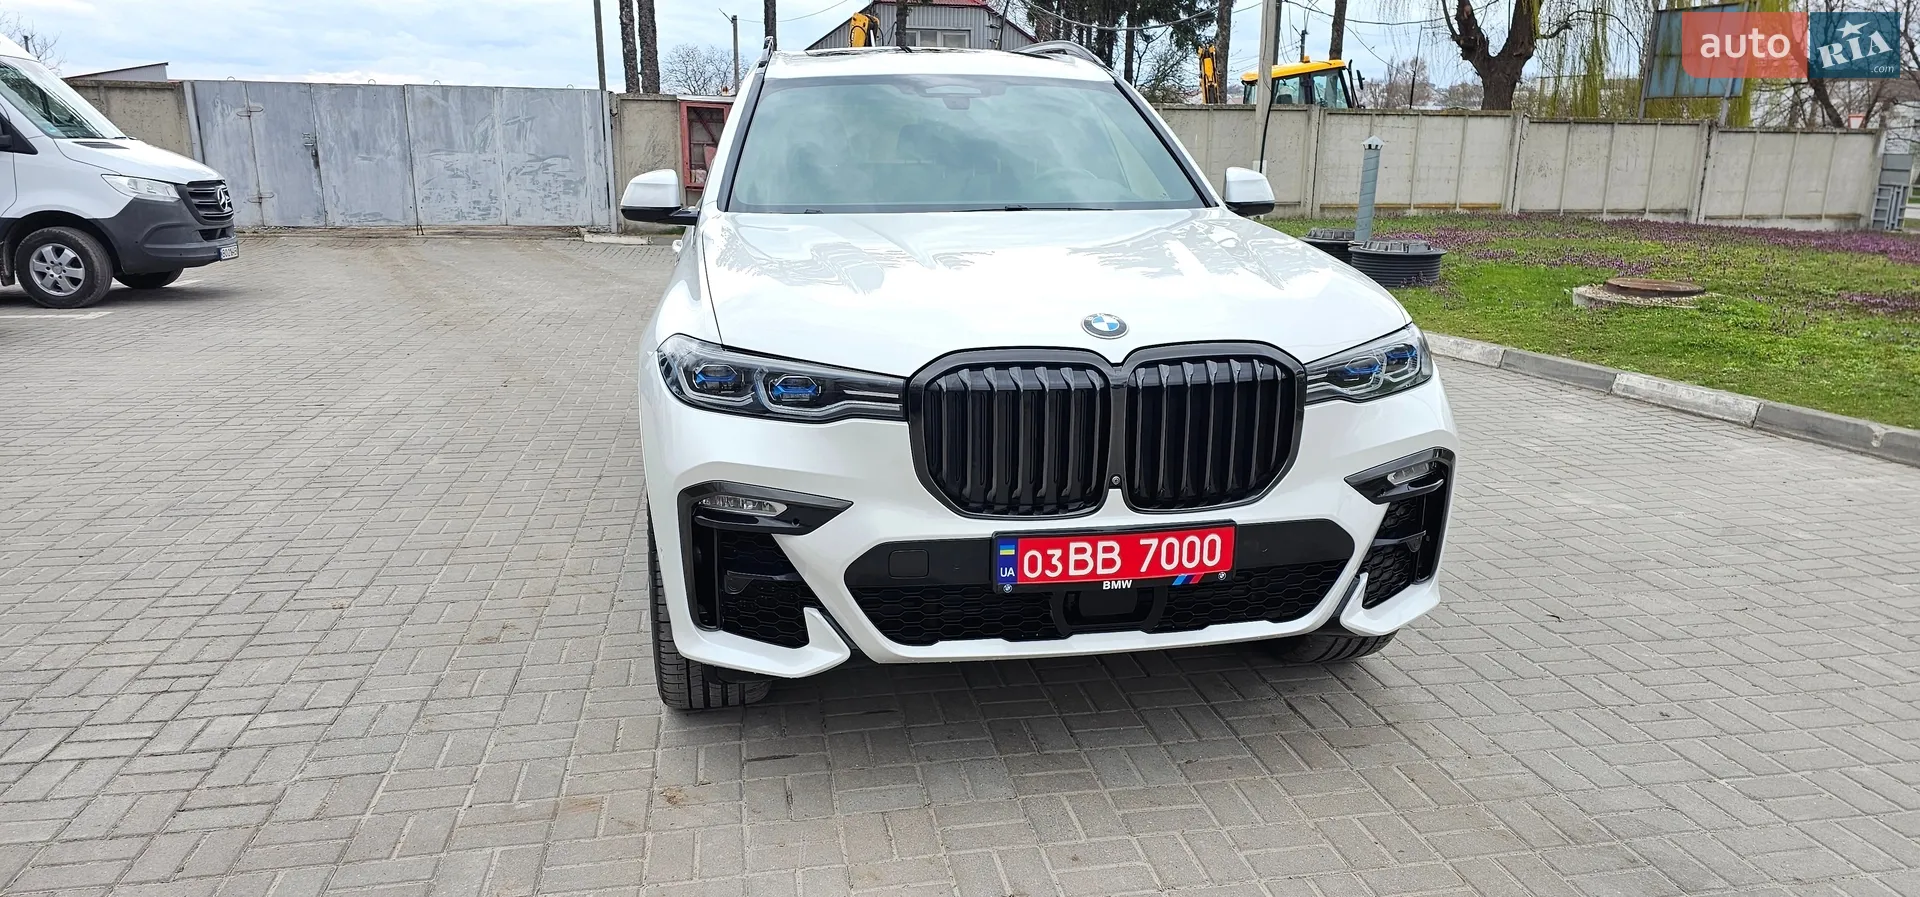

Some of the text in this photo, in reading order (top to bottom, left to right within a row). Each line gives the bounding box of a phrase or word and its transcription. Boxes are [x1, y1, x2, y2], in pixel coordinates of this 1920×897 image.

[1139, 533, 1222, 573] 7000
[1000, 567, 1015, 578] UA
[1102, 580, 1132, 590] BMW
